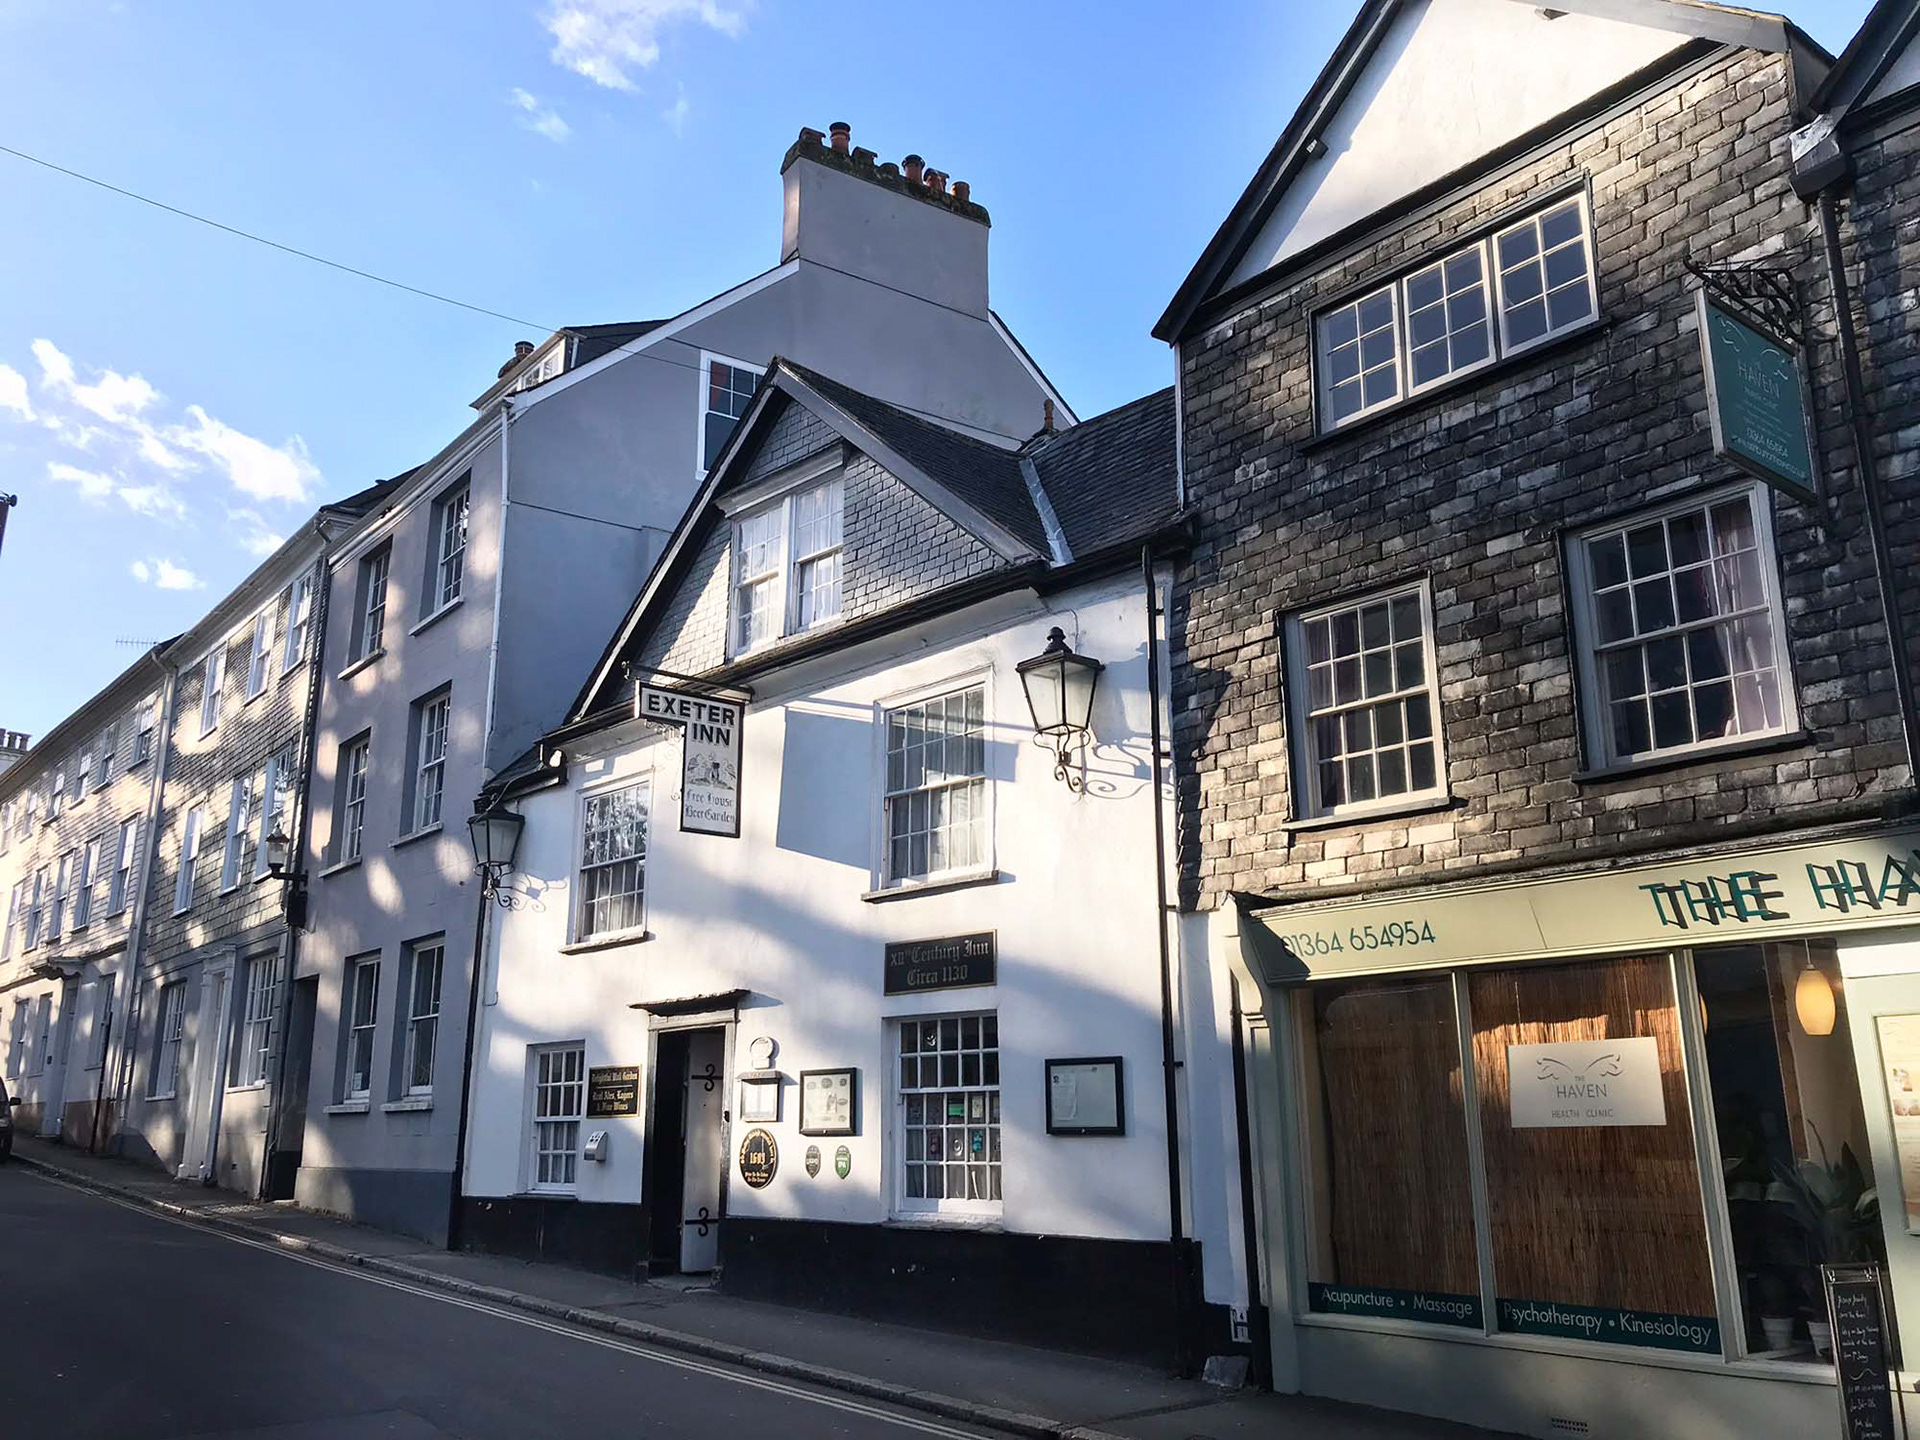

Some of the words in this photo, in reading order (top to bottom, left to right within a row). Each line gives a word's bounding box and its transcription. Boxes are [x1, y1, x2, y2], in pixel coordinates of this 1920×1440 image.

[1737, 360, 1780, 399] HAVEN
[648, 694, 735, 726] EXETER
[693, 722, 731, 747] INN
[685, 804, 704, 819] Beer
[704, 808, 735, 823] Garden
[1639, 870, 1780, 927] THE
[911, 945, 961, 964] Century
[963, 939, 989, 957] Inn
[1281, 930, 1345, 958] 01364
[1350, 920, 1436, 952] 654954
[906, 968, 938, 986] Circa
[942, 964, 969, 982] 1130
[1556, 1083, 1607, 1099] HAVEN
[1551, 1109, 1580, 1118] HEALTH
[1586, 1109, 1613, 1118] CLINIC
[1321, 1288, 1394, 1310] Acupuncture
[1413, 1294, 1473, 1319] Massage
[1503, 1302, 1603, 1335] Psychotherapy
[1619, 1312, 1712, 1345] Kinesiology
